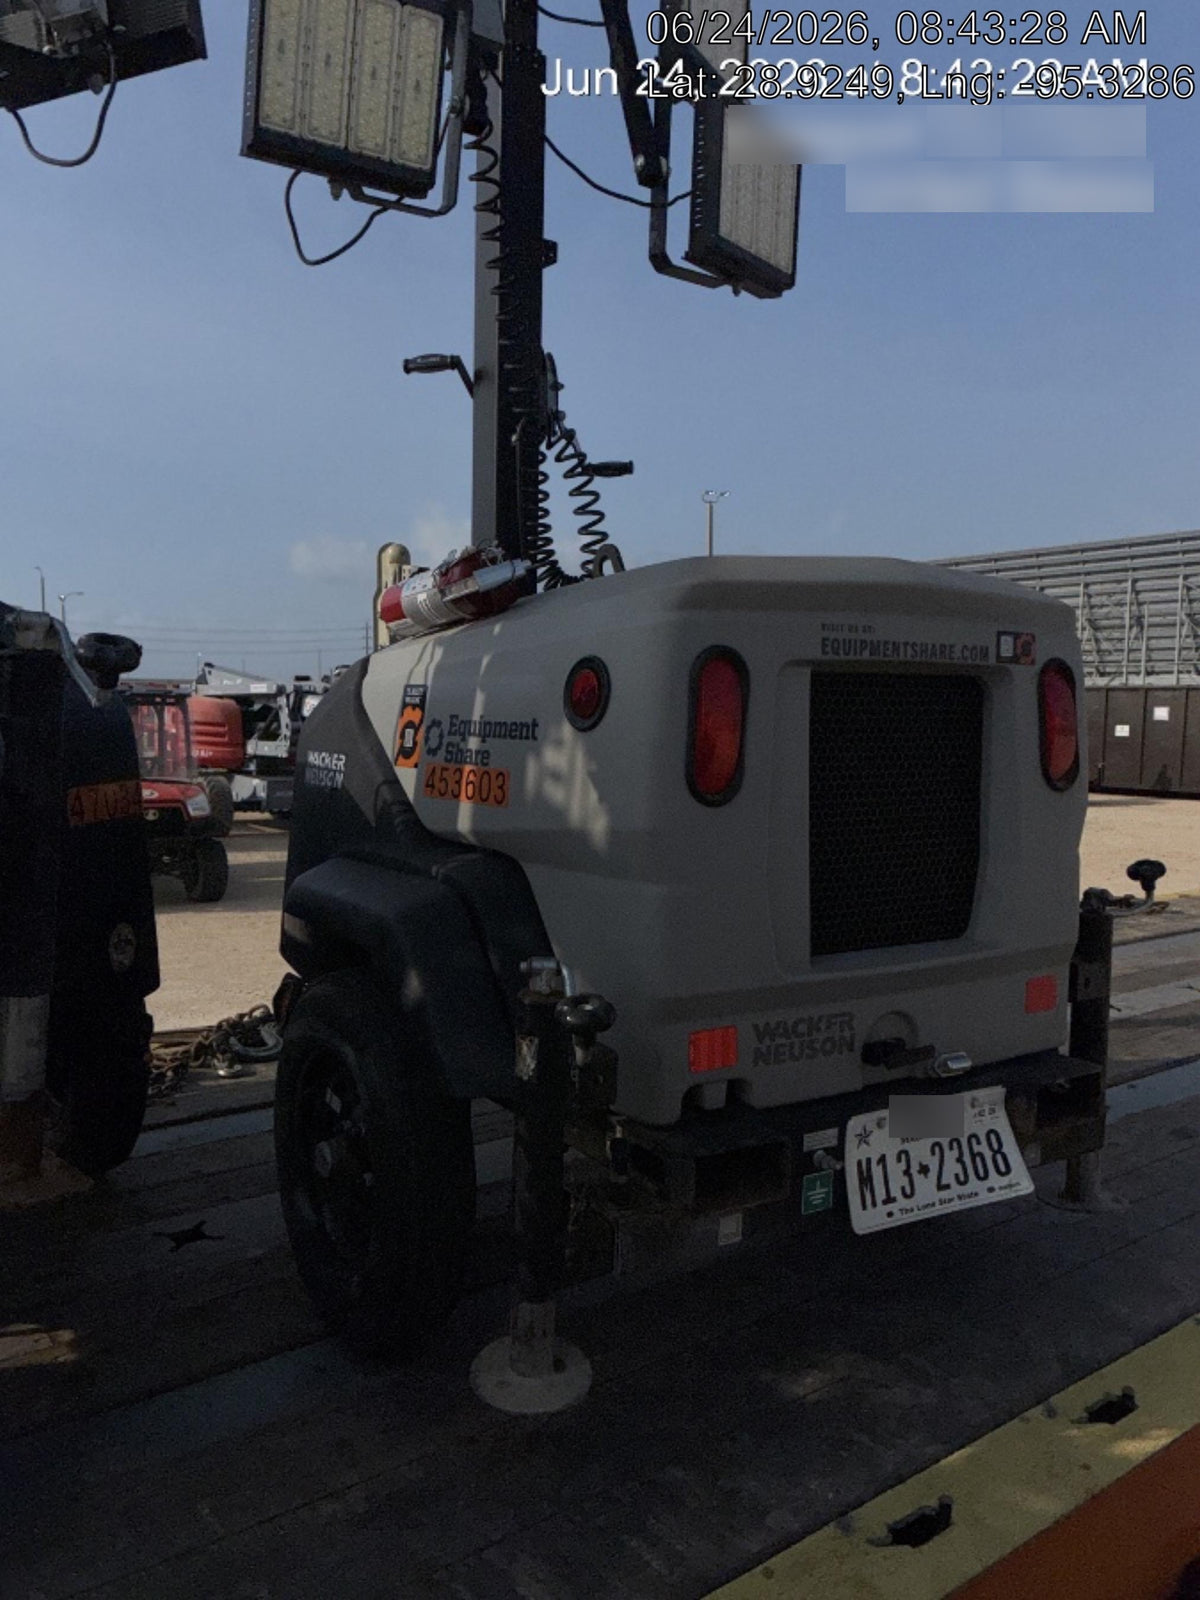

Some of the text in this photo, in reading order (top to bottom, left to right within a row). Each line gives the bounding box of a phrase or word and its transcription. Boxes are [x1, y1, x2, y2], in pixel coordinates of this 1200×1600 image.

[820, 636, 990, 663] EQUIPMENTSHARE.COM
[447, 714, 539, 742] Equipment
[307, 750, 346, 771] WACKER
[445, 741, 490, 767] Share
[424, 765, 507, 805] 453603
[751, 1011, 856, 1045] WACKER
[751, 1033, 856, 1067] NEUSON
